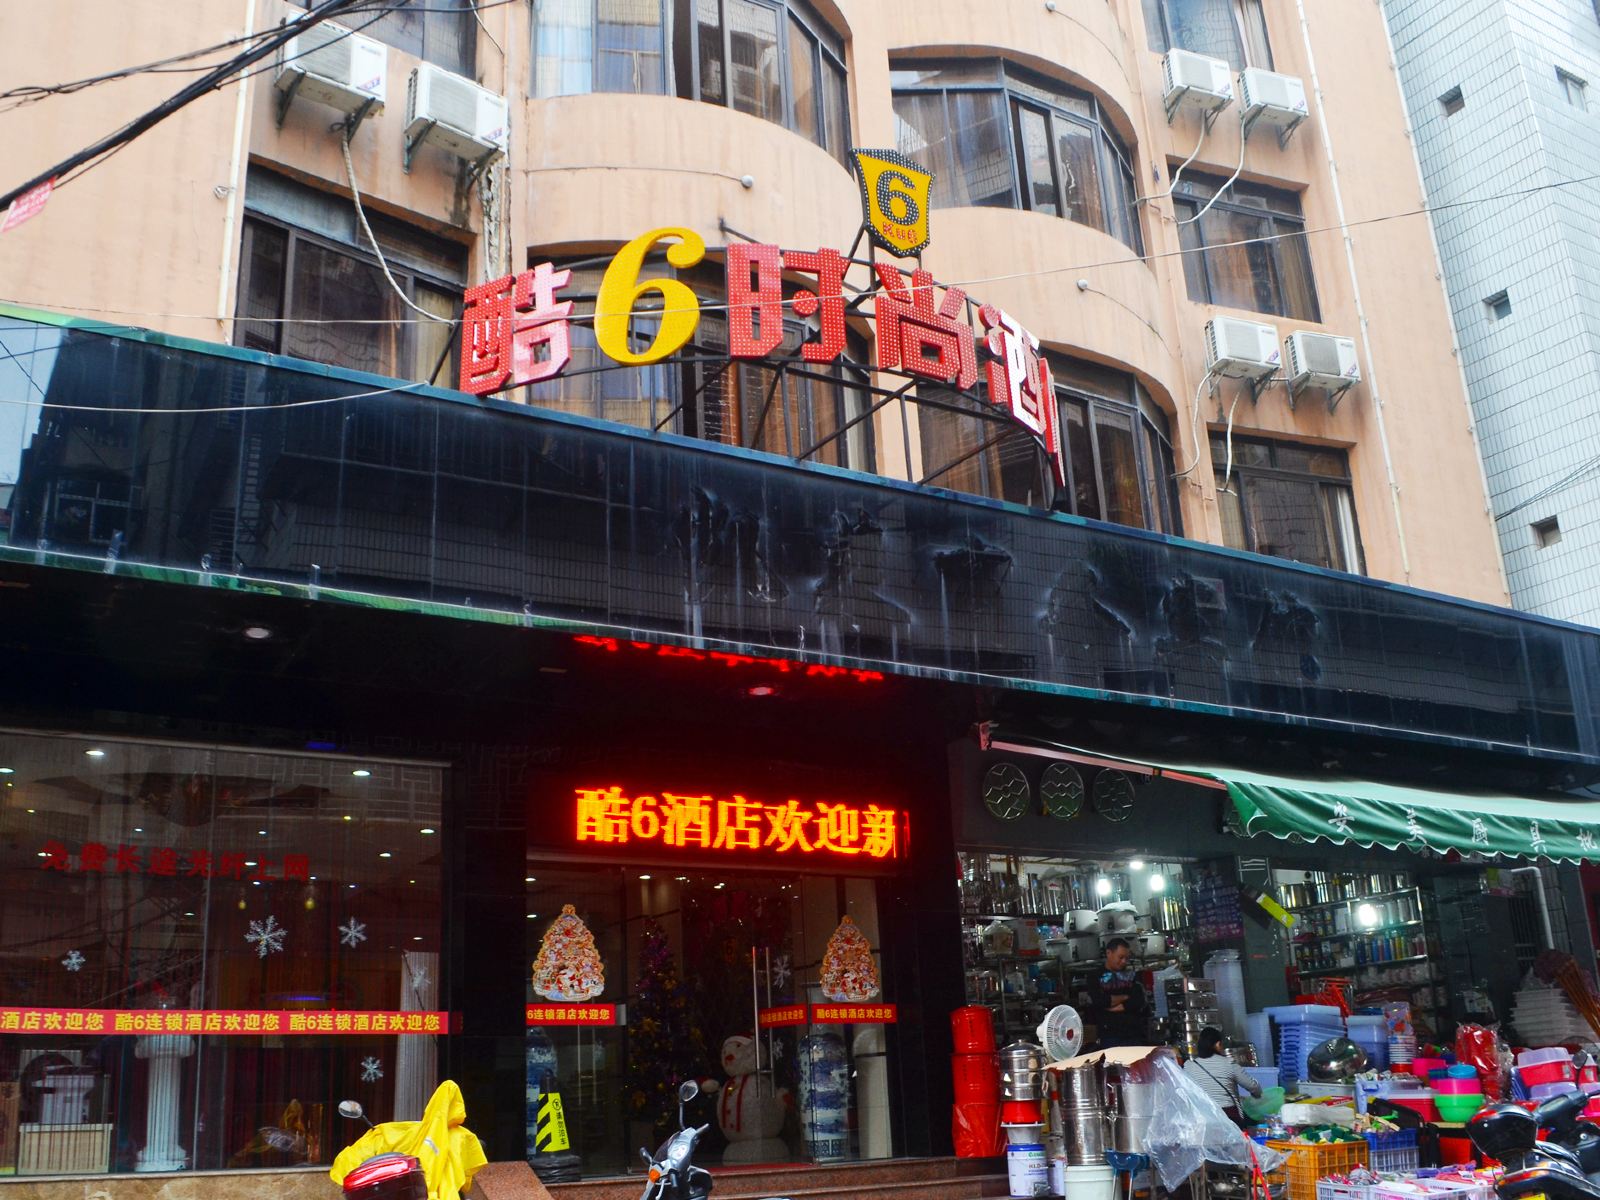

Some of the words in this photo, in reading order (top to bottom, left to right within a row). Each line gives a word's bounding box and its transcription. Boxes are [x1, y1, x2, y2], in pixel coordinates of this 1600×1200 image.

[876, 170, 920, 226] 6
[459, 227, 1066, 488] 酷6时尚酒
[1, 1011, 105, 1031] 酒店欢迎您
[114, 1013, 280, 1031] 酷6连锁酒店欢迎您
[289, 1014, 440, 1031] 酷6连锁酒店欢迎您
